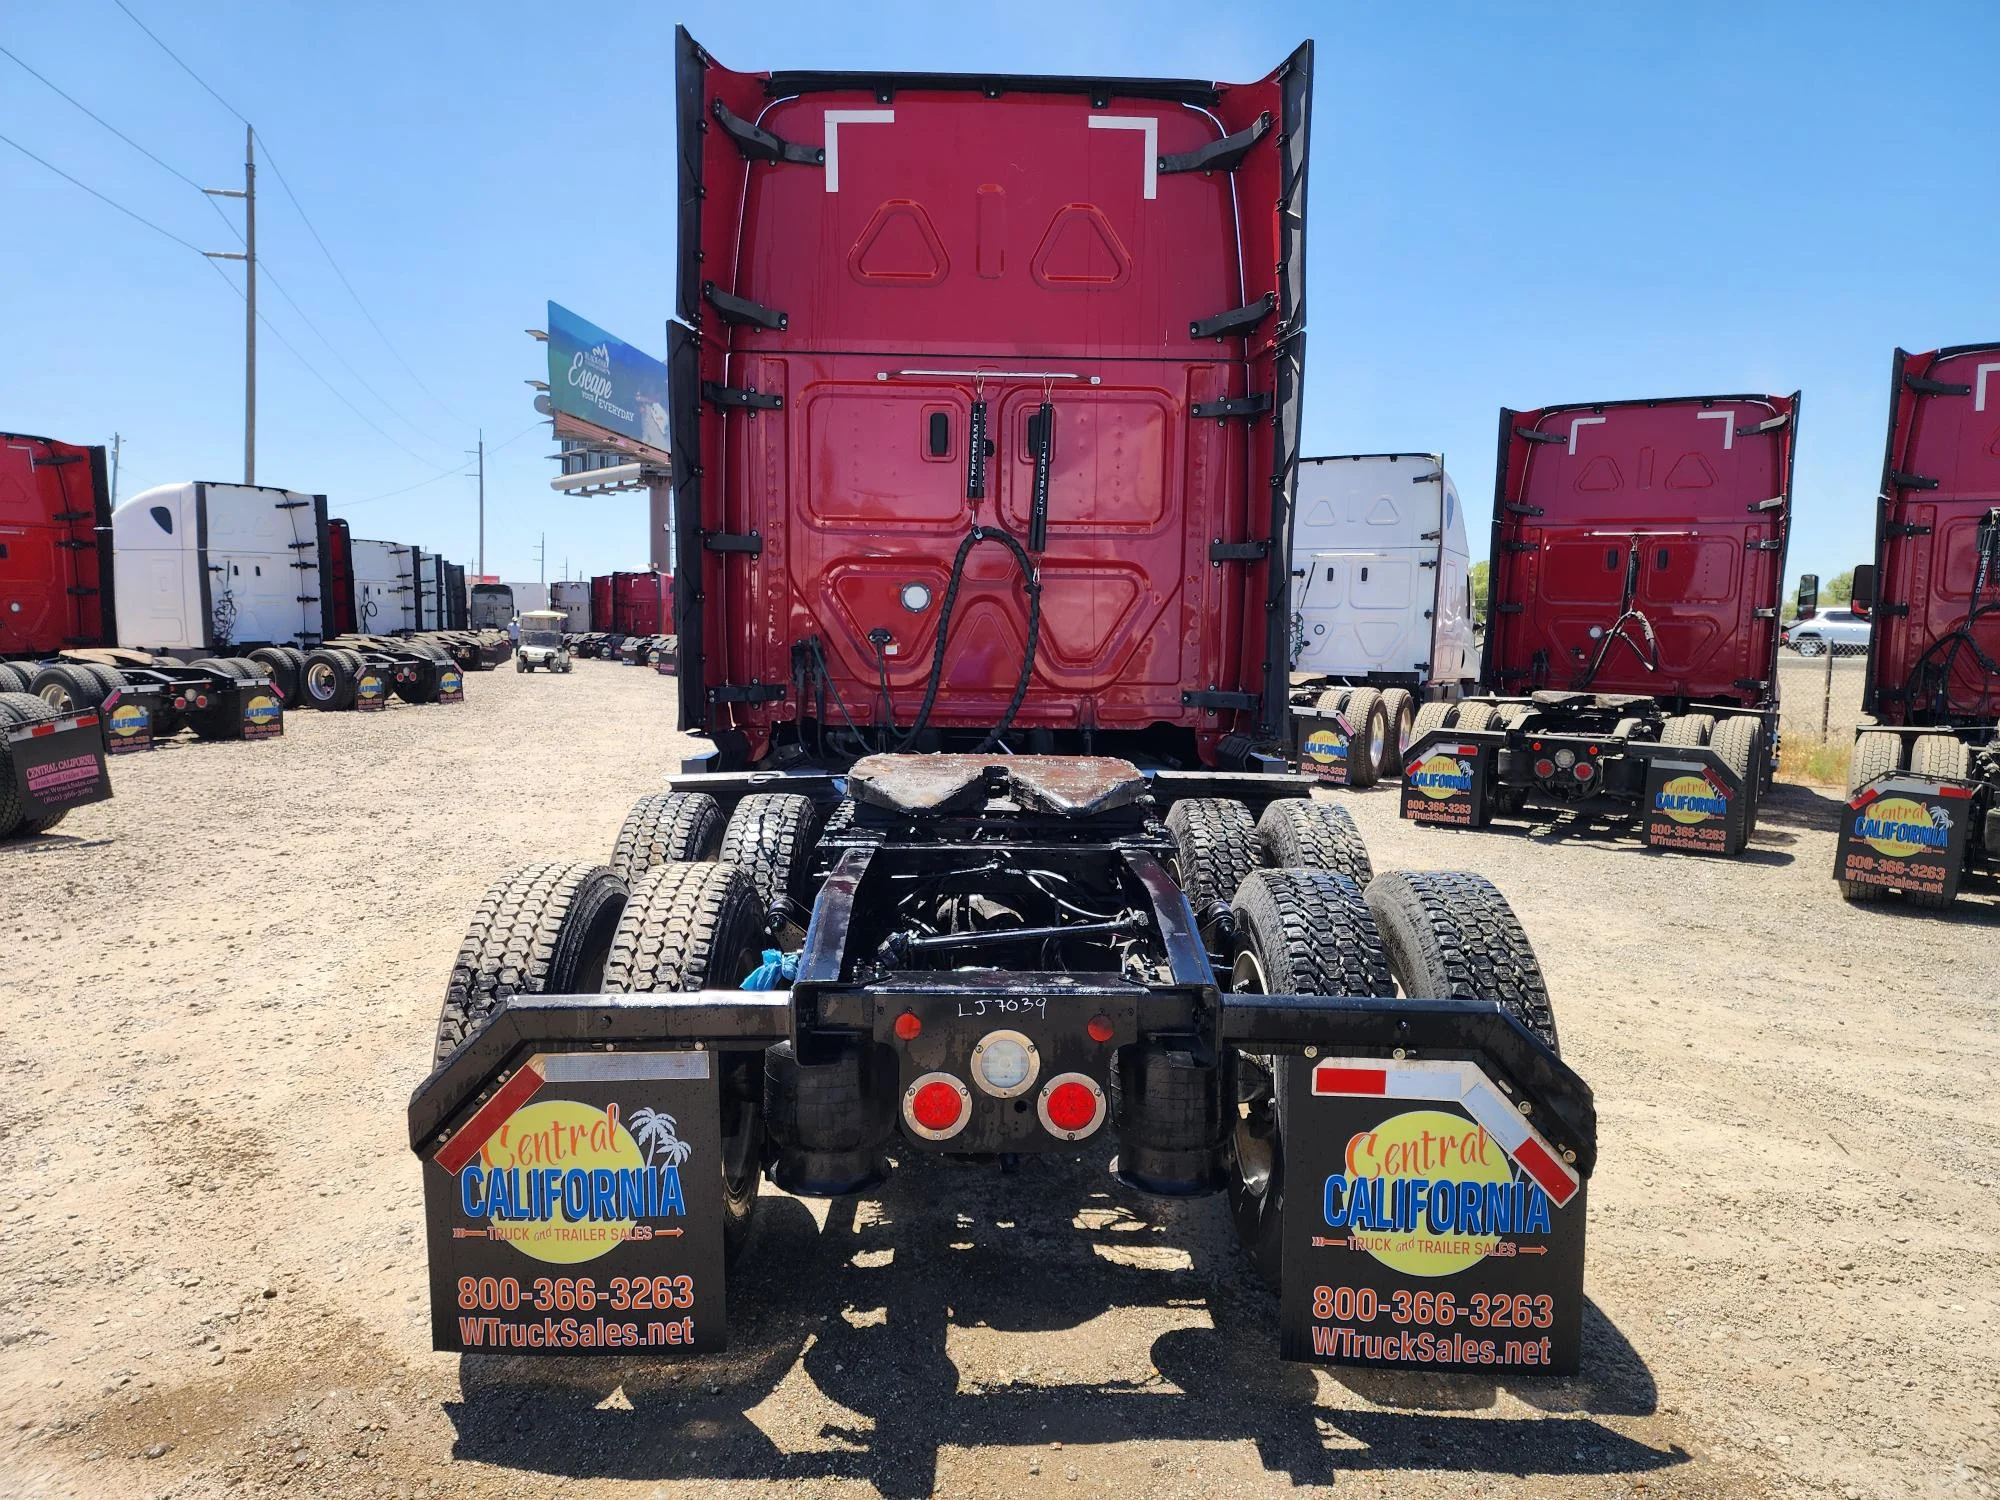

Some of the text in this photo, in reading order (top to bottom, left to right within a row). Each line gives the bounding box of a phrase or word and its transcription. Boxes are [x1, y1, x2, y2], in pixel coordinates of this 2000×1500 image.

[568, 352, 612, 402] Escape
[598, 399, 634, 421] EVERYDAY
[1039, 452, 1047, 504] TECTRAN
[27, 754, 97, 779] CENTRAL CALIFORNIA
[1409, 770, 1472, 790] CALIFORNIA
[1407, 799, 1472, 815] 800-366-3263
[1655, 792, 1727, 815] CALIFORNIA
[1864, 802, 1927, 821] Central
[1406, 809, 1471, 825] WTruckSales.net
[1649, 834, 1726, 852] WTruckSales.net
[1650, 823, 1726, 842] 800-366-3263
[1854, 816, 1948, 848] CALIFORNIA
[1846, 854, 1946, 881] 800-366-3263
[1845, 868, 1944, 894] WTruckSales.net
[480, 1102, 622, 1172] Central
[1344, 1124, 1491, 1182] Central
[461, 1165, 687, 1222] CALIFORNIA
[1323, 1174, 1551, 1237] CALIFORNIA
[486, 1226, 653, 1242] TRUCK and TRAILER SALES
[1347, 1235, 1517, 1258] TRUCK and TRAILER SALES
[457, 1275, 695, 1311] 800-366-3263
[1312, 1285, 1554, 1329] 800-366-3263
[459, 1316, 695, 1347] WTruckSales.net
[1311, 1326, 1551, 1366] WTruckSales.net
